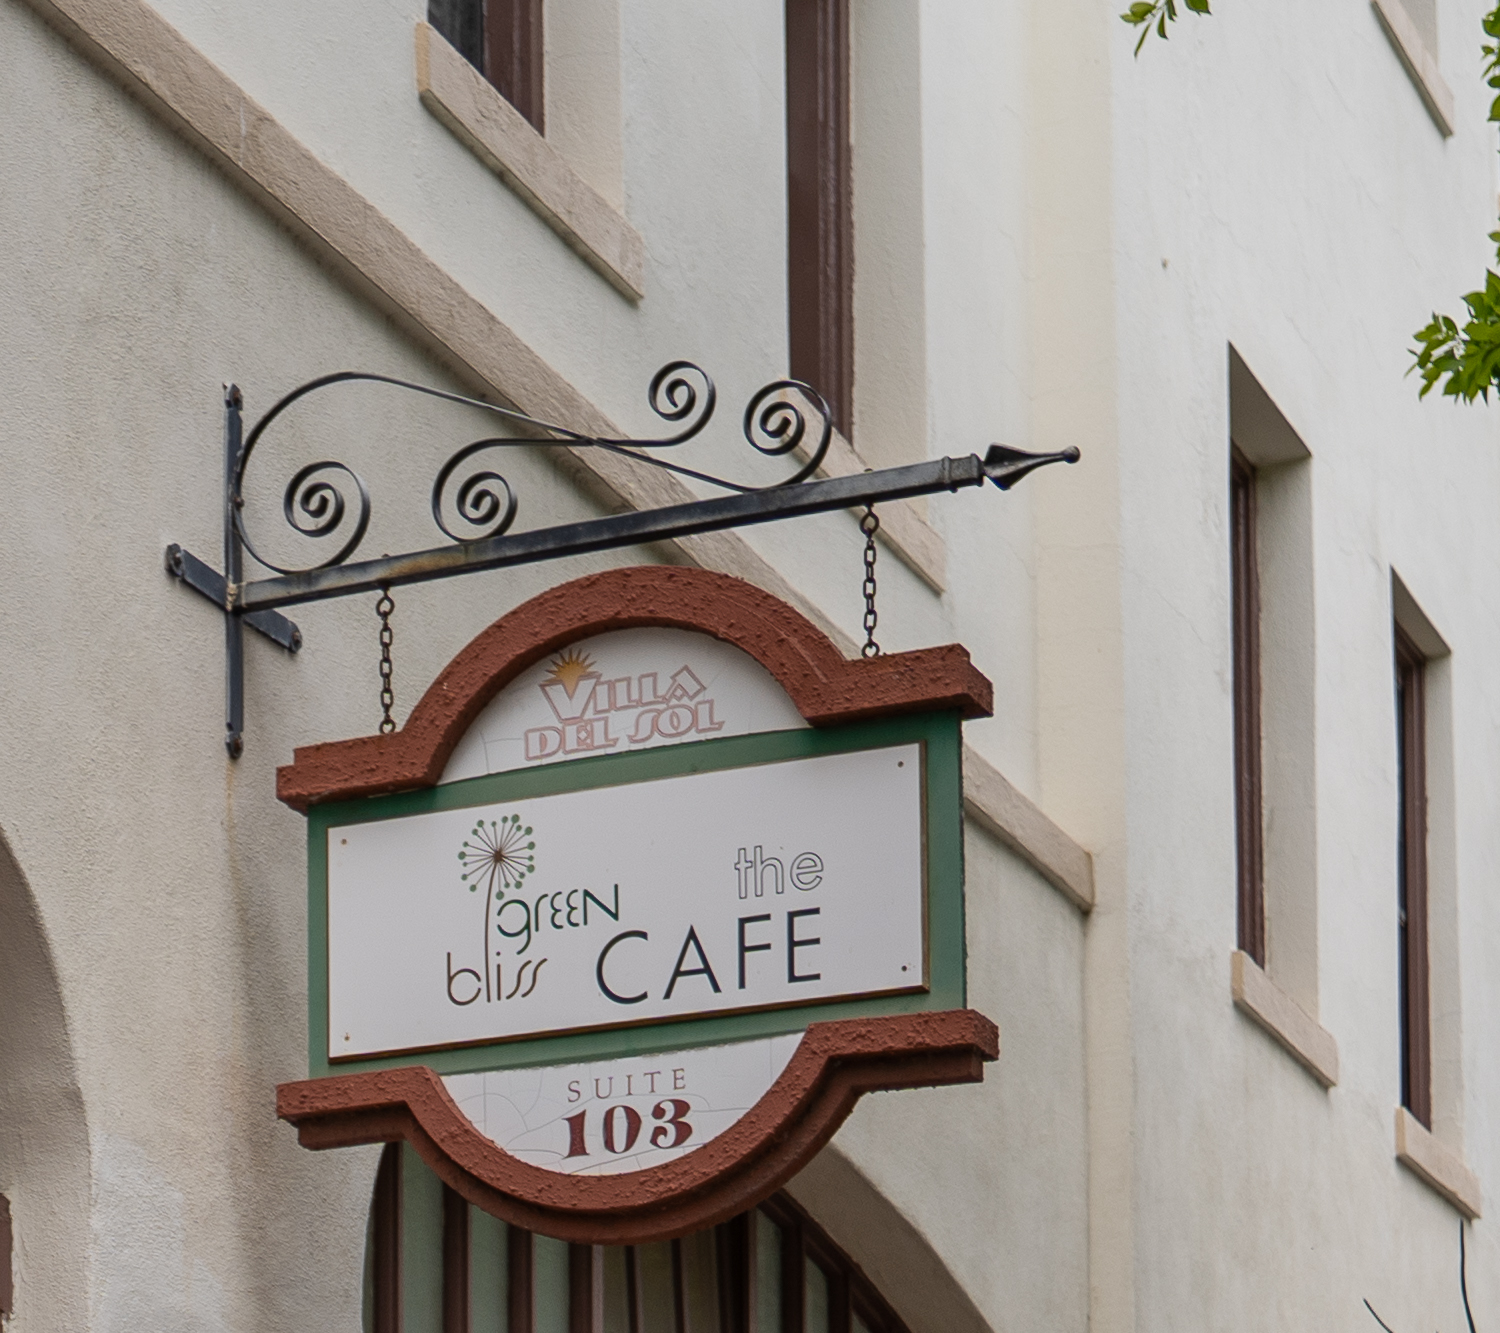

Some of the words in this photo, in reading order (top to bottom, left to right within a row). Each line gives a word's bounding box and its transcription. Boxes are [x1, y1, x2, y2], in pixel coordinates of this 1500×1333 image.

[539, 664, 706, 721] VILLA
[523, 713, 618, 761] DEL
[628, 699, 725, 746] SOL
[734, 844, 825, 900] the
[446, 950, 548, 1008] bliss
[595, 906, 823, 1006] CAFE
[567, 1067, 688, 1105] SUITE
[561, 1098, 694, 1162] 103
